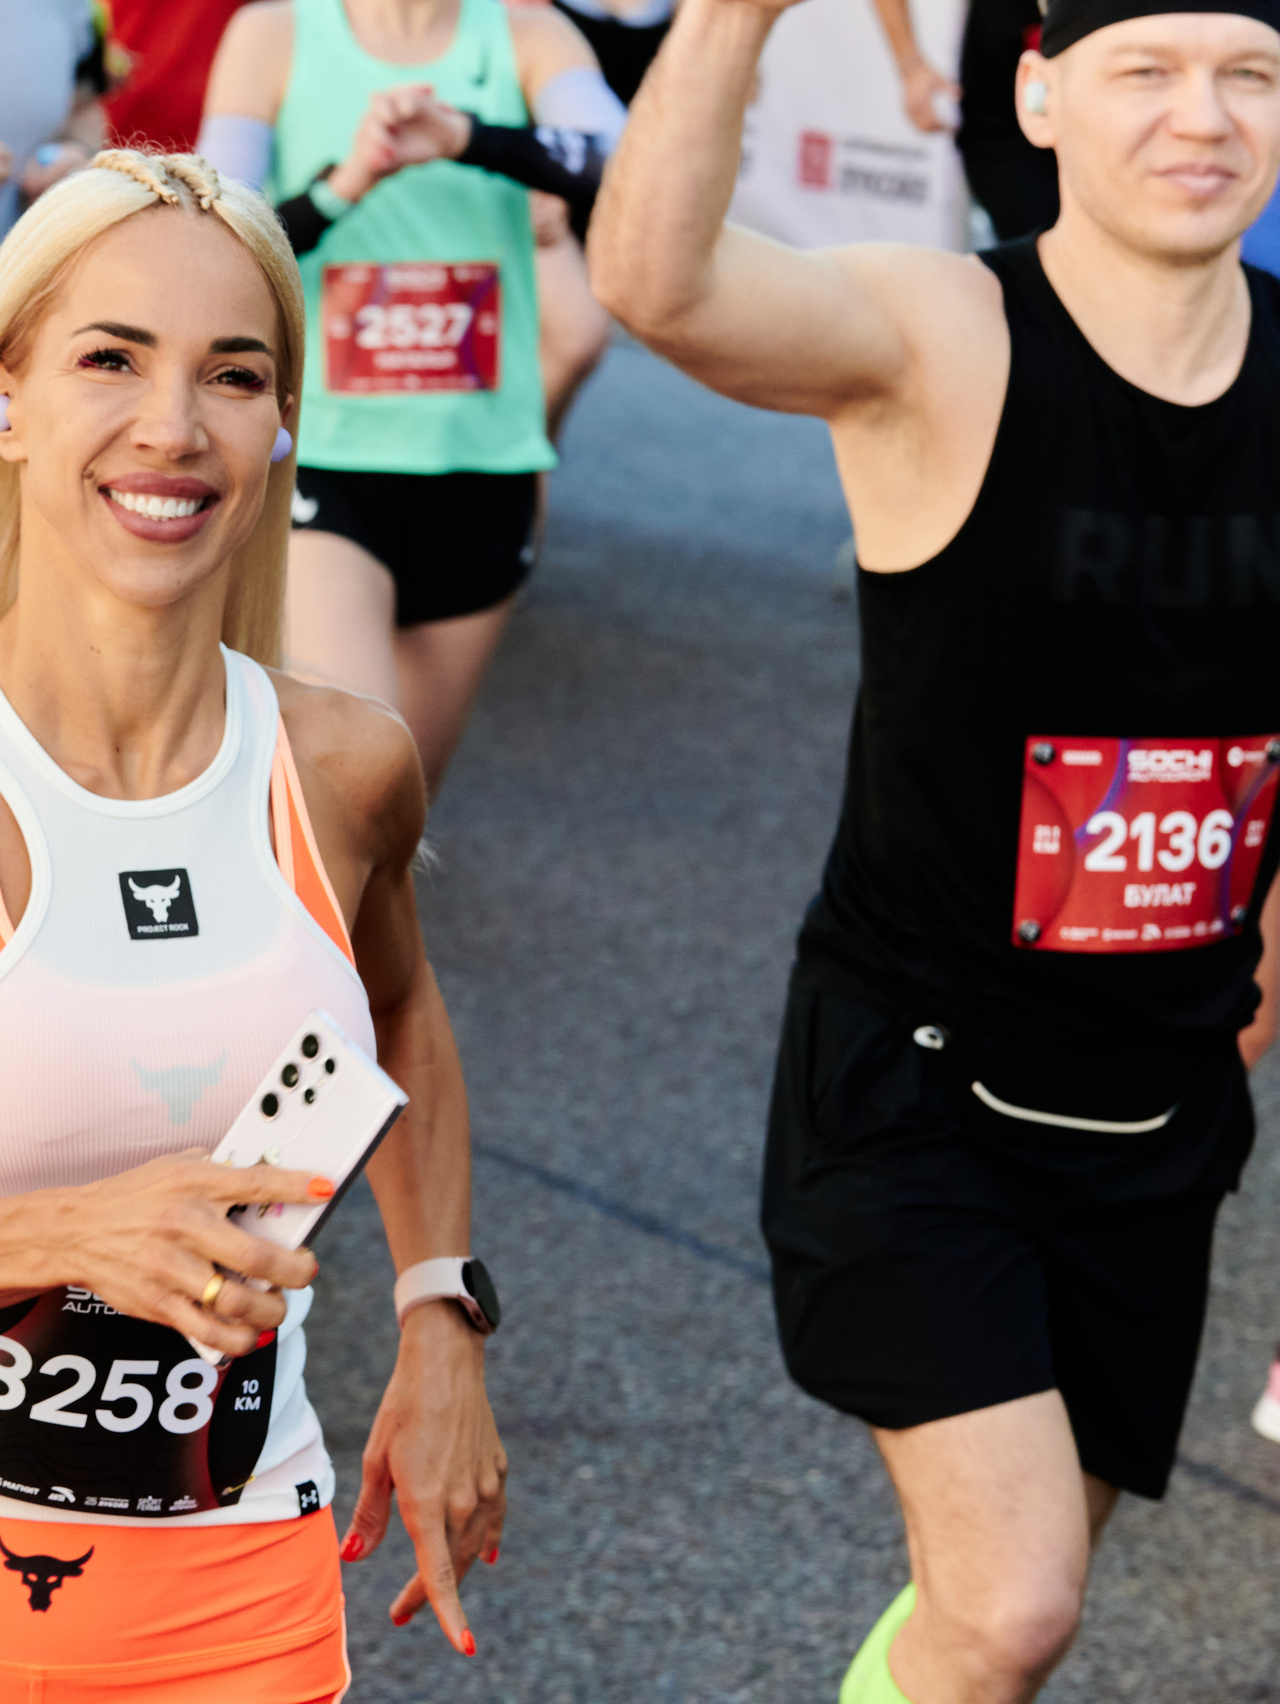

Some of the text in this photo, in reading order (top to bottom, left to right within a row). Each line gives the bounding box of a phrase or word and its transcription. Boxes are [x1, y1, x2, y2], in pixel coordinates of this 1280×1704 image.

[357, 303, 473, 348] 2527
[1084, 809, 1234, 872] 2136
[1124, 882, 1197, 908] БУЛАТ
[136, 922, 189, 933] PROJECT ROCK
[61, 1301, 127, 1316] AUTO
[242, 1379, 259, 1395] 10
[234, 1396, 261, 1411] KM
